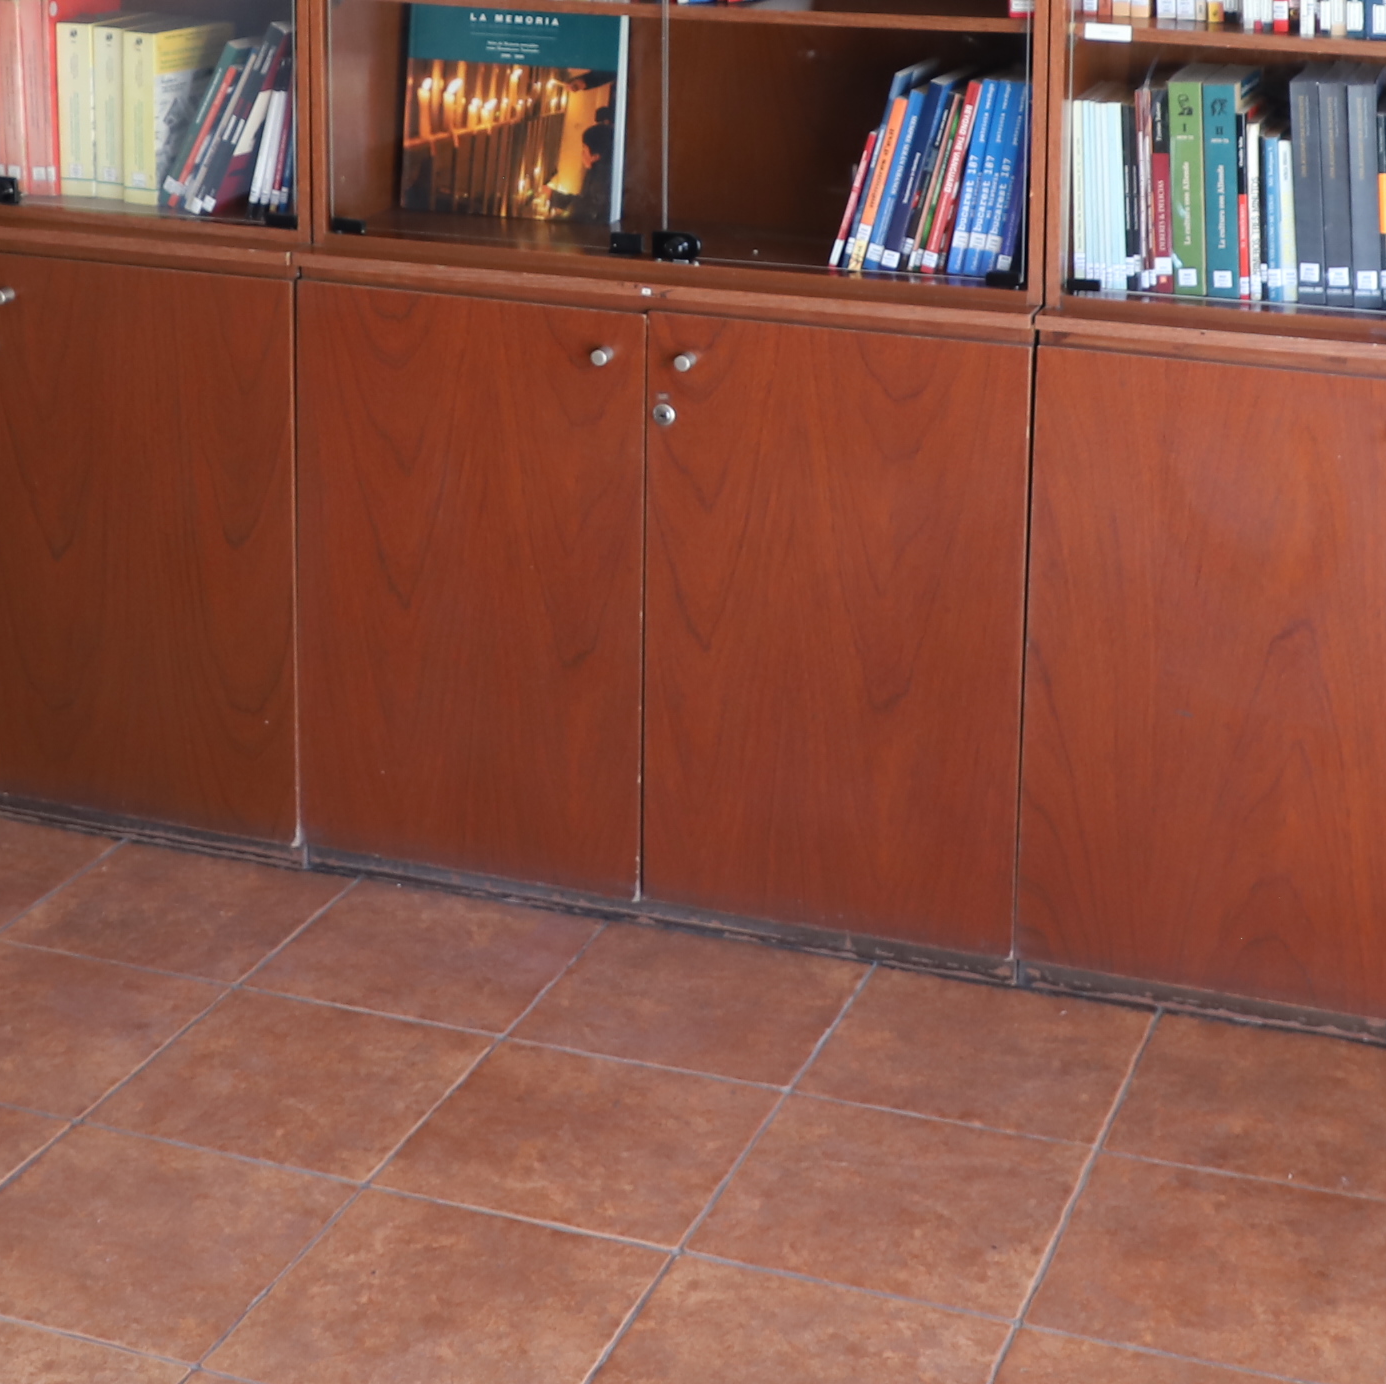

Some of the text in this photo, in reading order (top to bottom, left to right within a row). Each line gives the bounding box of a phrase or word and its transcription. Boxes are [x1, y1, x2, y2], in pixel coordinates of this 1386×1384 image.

[469, 12, 560, 27] LA MEMORIA
[944, 105, 973, 193] BEYOND THE VANGUARD
[957, 154, 979, 231] bucarest 187
[973, 155, 995, 232] bucarest 187
[989, 157, 1011, 234] bucarest 187
[1217, 165, 1225, 194] Allende
[1157, 180, 1165, 212] DELICIAS
[1182, 161, 1192, 245] La cultura con Allende
[1158, 220, 1166, 251] DEBERES
[1218, 211, 1226, 238] cultura
[1219, 240, 1226, 249] La
